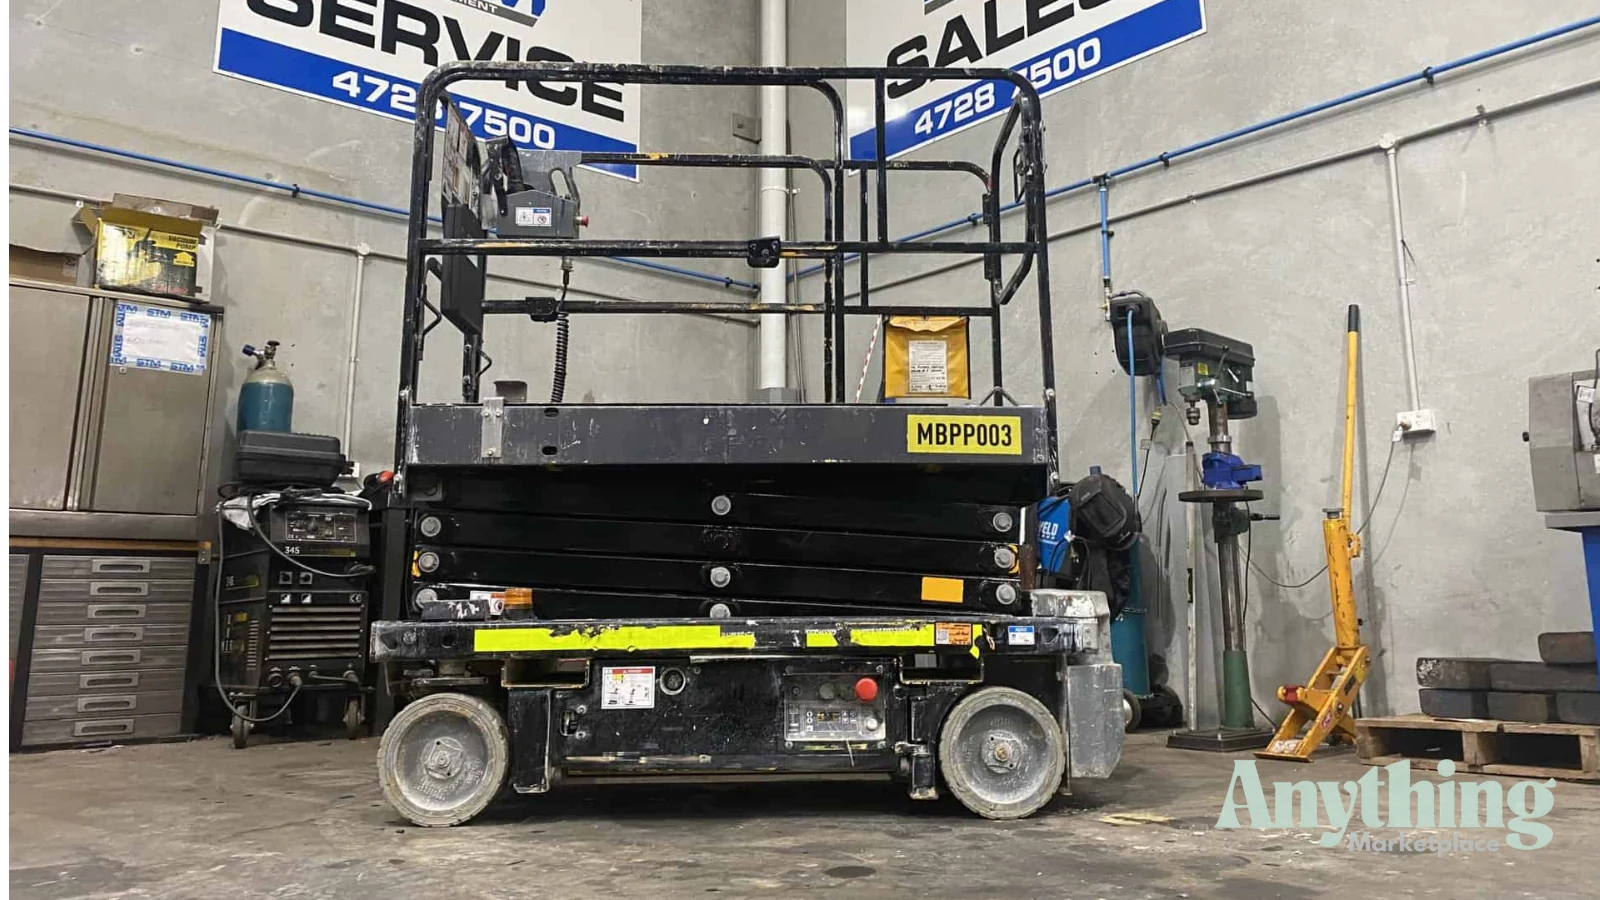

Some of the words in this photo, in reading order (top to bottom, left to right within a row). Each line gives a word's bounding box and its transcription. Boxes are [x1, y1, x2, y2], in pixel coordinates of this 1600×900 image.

[886, 0, 1112, 99] SALE
[332, 70, 444, 121] 472
[459, 101, 556, 150] 7500
[914, 82, 995, 135] 4728
[147, 308, 171, 318] STM
[198, 336, 207, 357] STM
[136, 358, 161, 368] STM
[170, 362, 194, 373] STM
[917, 422, 1012, 447] MBPP003
